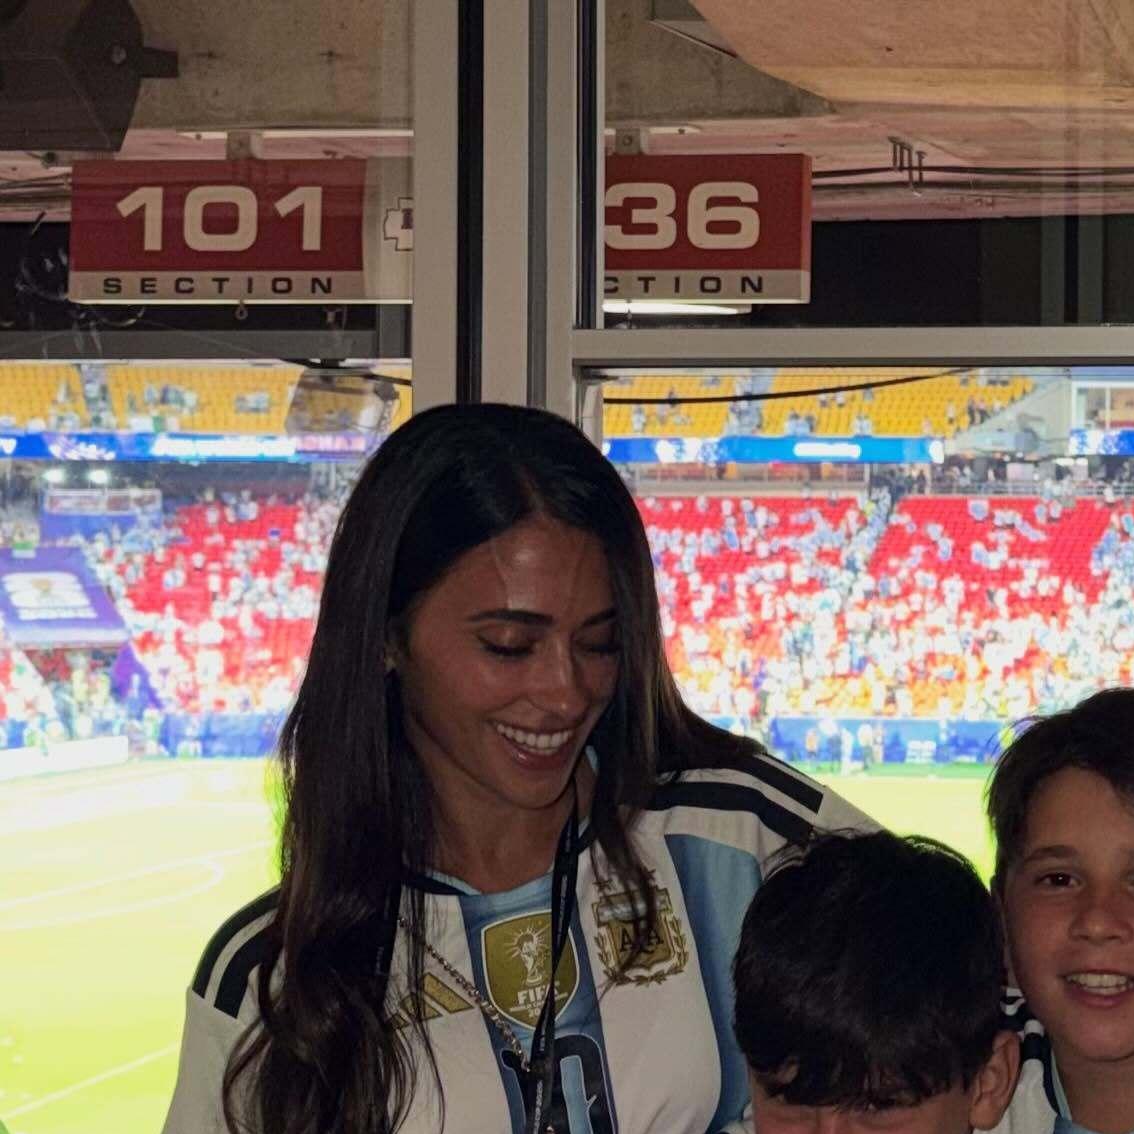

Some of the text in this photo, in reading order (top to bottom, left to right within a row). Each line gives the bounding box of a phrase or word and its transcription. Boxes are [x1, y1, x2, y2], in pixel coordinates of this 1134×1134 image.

[116, 185, 324, 252] 101
[605, 181, 760, 250] 36
[103, 277, 334, 295] SECTION
